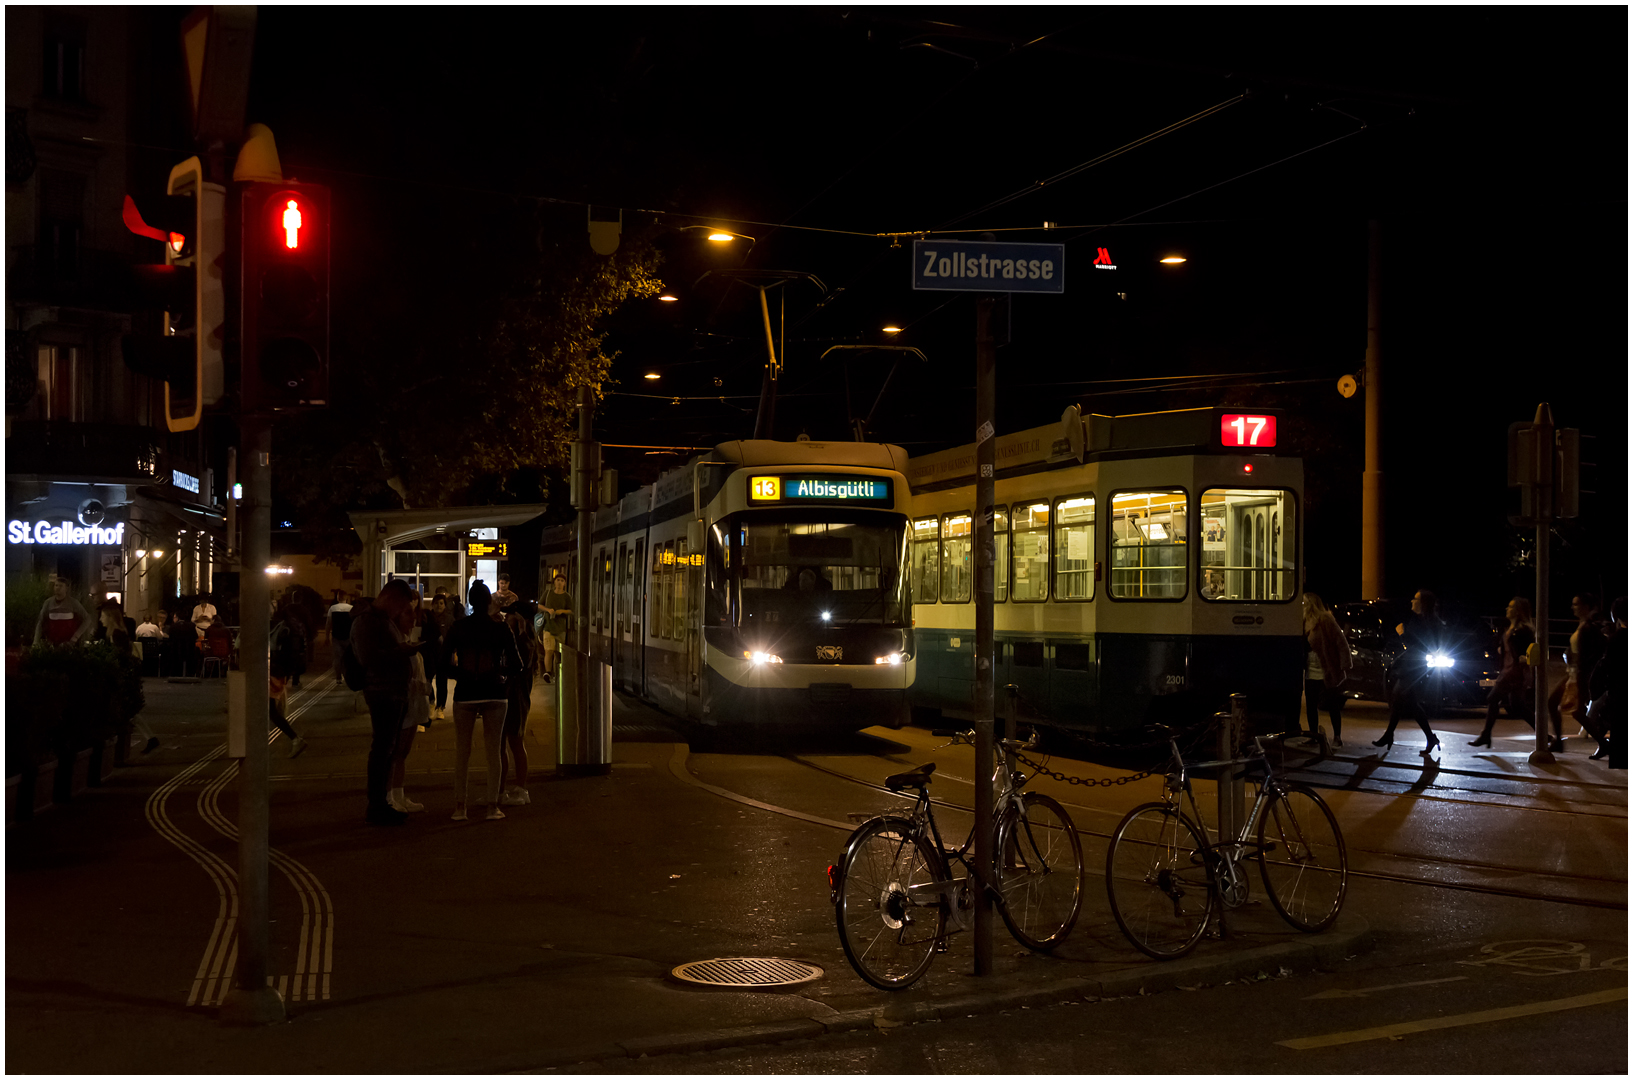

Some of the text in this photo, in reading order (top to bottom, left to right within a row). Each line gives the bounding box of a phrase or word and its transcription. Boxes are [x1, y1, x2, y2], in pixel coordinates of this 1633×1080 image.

[923, 250, 1054, 280] Zollstrasse
[1231, 416, 1266, 445] 17
[756, 480, 776, 497] 13
[798, 479, 874, 499] Albisgütli
[1166, 674, 1185, 685] 2301
